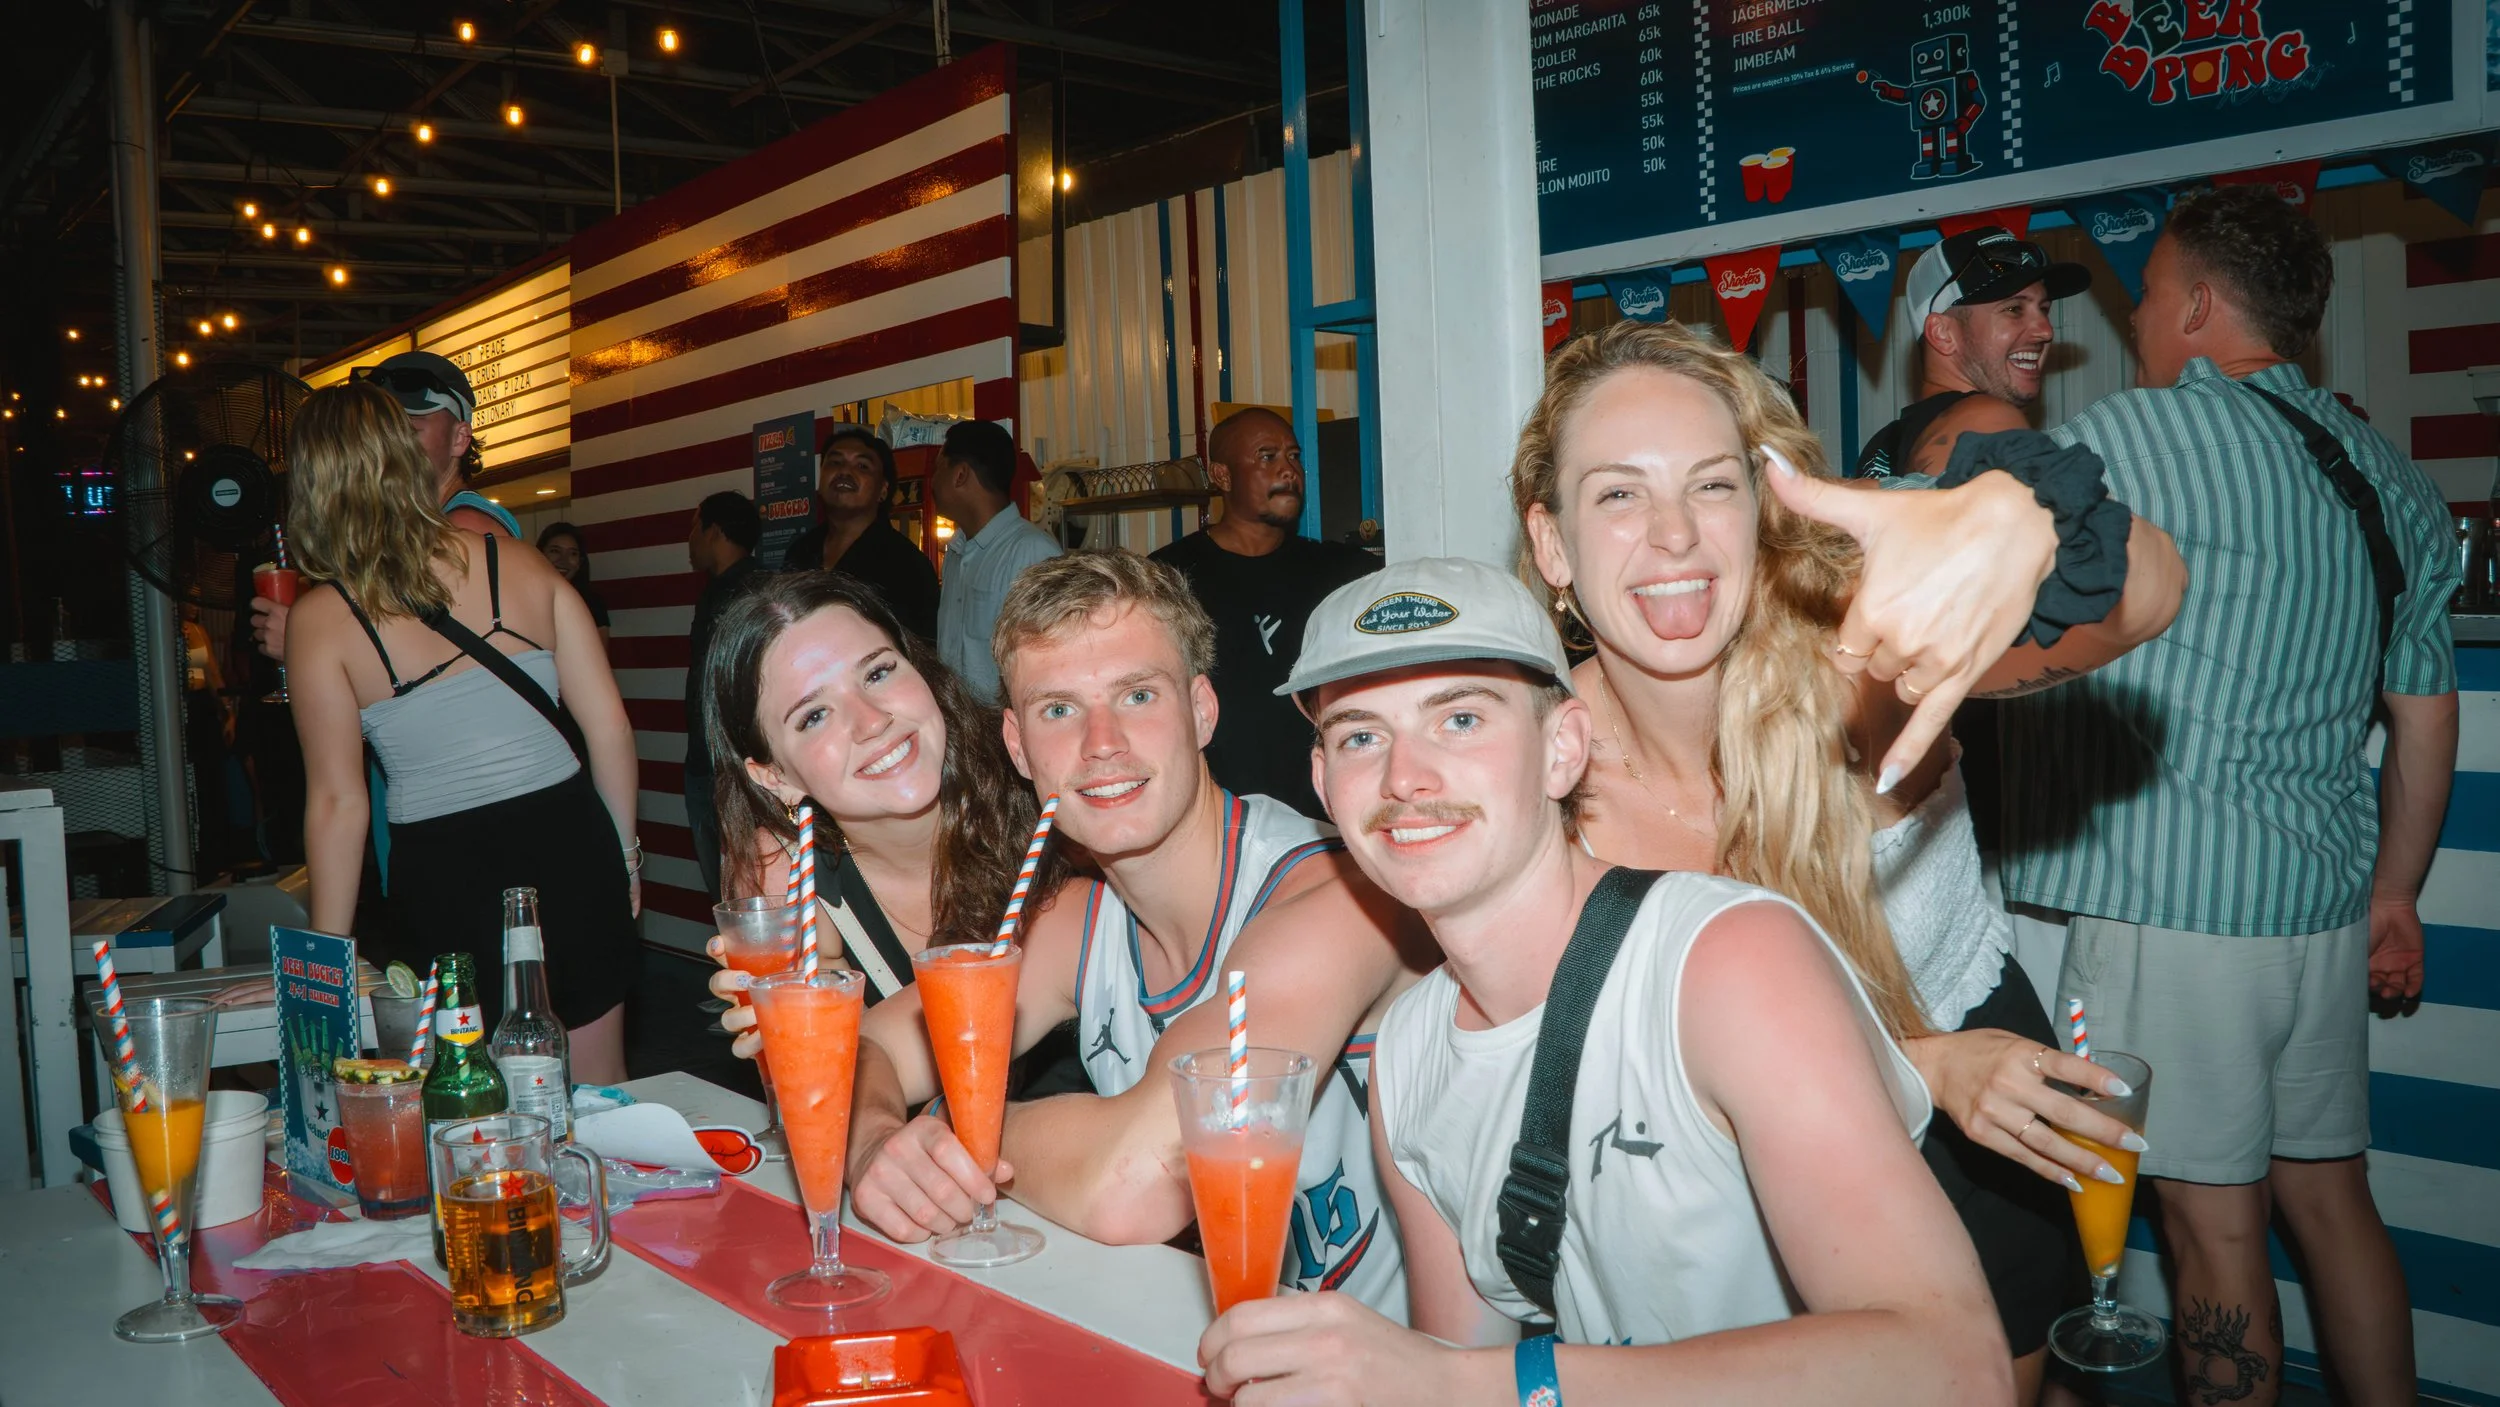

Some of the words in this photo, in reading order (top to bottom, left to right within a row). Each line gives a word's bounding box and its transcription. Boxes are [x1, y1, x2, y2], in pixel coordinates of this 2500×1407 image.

[1638, 4, 1660, 21] 65k
[1922, 4, 1971, 29] 1,300k
[1555, 13, 1627, 43] MARGARITA
[1639, 25, 1661, 42] 65k
[1733, 27, 1764, 48] FIRE
[1767, 18, 1805, 40] BALL
[1640, 47, 1663, 64] 60k
[1734, 45, 1796, 72] JIMBEAM
[1534, 74, 1557, 91] THE
[1560, 62, 1601, 85] ROCKS
[1640, 69, 1664, 86] 60k
[1733, 84, 1751, 94] Prices
[1762, 77, 1783, 89] subject
[1805, 70, 1814, 79] Tax
[1832, 62, 1855, 72] Service
[1641, 91, 1663, 108] 55k
[1642, 113, 1665, 129] 55k
[1642, 134, 1665, 151] 50k
[1643, 157, 1666, 173] 50k
[1568, 168, 1610, 189] MOJITO
[2093, 209, 2151, 239] Shooters
[1837, 250, 1886, 277] Shooters
[1718, 268, 1763, 293] Shooters
[1621, 287, 1661, 311] Shooters
[480, 338, 506, 361] PEACE
[476, 363, 501, 384] CRUST
[505, 373, 531, 395] PIZZA
[767, 497, 810, 521] BURGERS
[1372, 596, 1402, 612] GREEN
[1405, 596, 1438, 607] THUMB
[1381, 610, 1410, 623] Your
[1377, 624, 1405, 632] SINCE
[450, 1025, 479, 1035] BINTANG
[507, 1206, 534, 1304] BINNG
